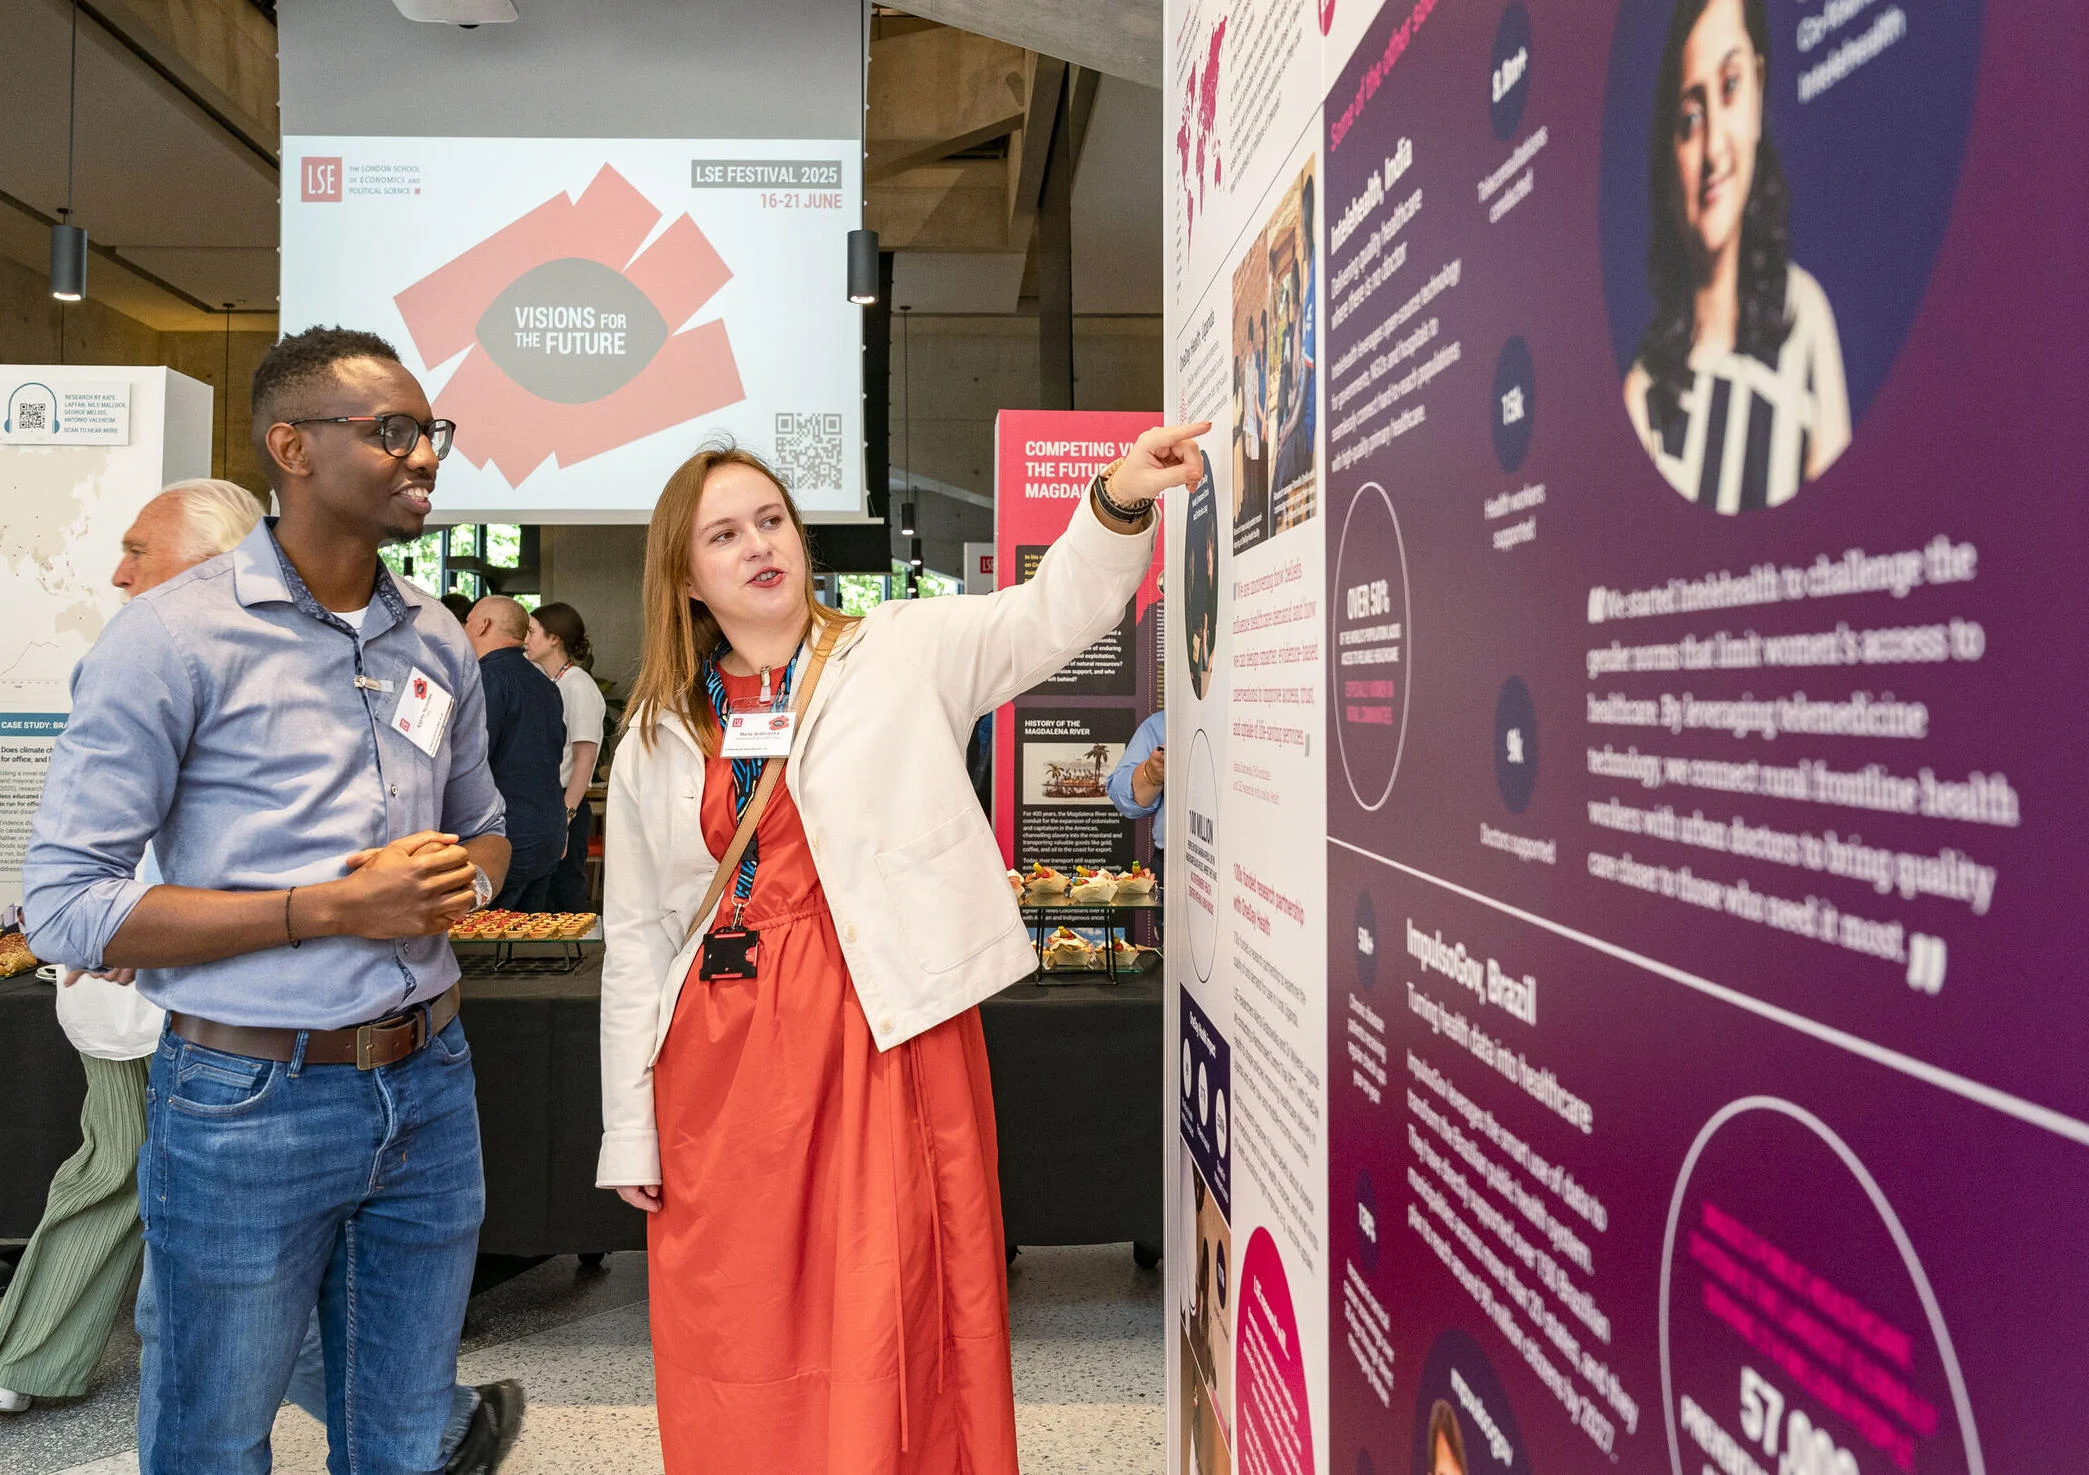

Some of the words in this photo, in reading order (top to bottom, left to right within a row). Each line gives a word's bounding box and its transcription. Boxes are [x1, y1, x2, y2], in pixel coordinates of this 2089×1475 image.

[308, 165, 335, 195] LSE
[360, 176, 405, 184] ECONOMICS
[696, 166, 723, 183] LSE
[727, 166, 797, 183] FESTIVAL
[801, 166, 838, 183] 2025
[1384, 136, 1412, 191] India
[760, 193, 800, 208] 16-21
[804, 193, 842, 208] JUNE
[514, 307, 595, 328] VISIONS
[600, 314, 626, 328] FOR
[514, 332, 540, 348] THE
[546, 332, 626, 354] FUTURE
[1025, 442, 1114, 457] COMPETING
[1025, 462, 1055, 478] THE
[1059, 462, 1106, 478] FUTU
[1805, 548, 1923, 600] challenge
[1924, 533, 1977, 584] the
[1347, 584, 1370, 620] OVER
[1762, 623, 1858, 666] women's
[1862, 625, 1948, 664] access
[1950, 618, 1985, 662] to
[1779, 692, 1929, 741] telemedicine
[12, 756, 33, 764] office,
[1919, 770, 2019, 829] health
[1893, 847, 1995, 915] quality
[1487, 957, 1537, 1027] Brazil
[1440, 1002, 1469, 1048] health
[1470, 1024, 1494, 1067] data
[1494, 1039, 1518, 1083] into
[1518, 1053, 1593, 1135] healthcare
